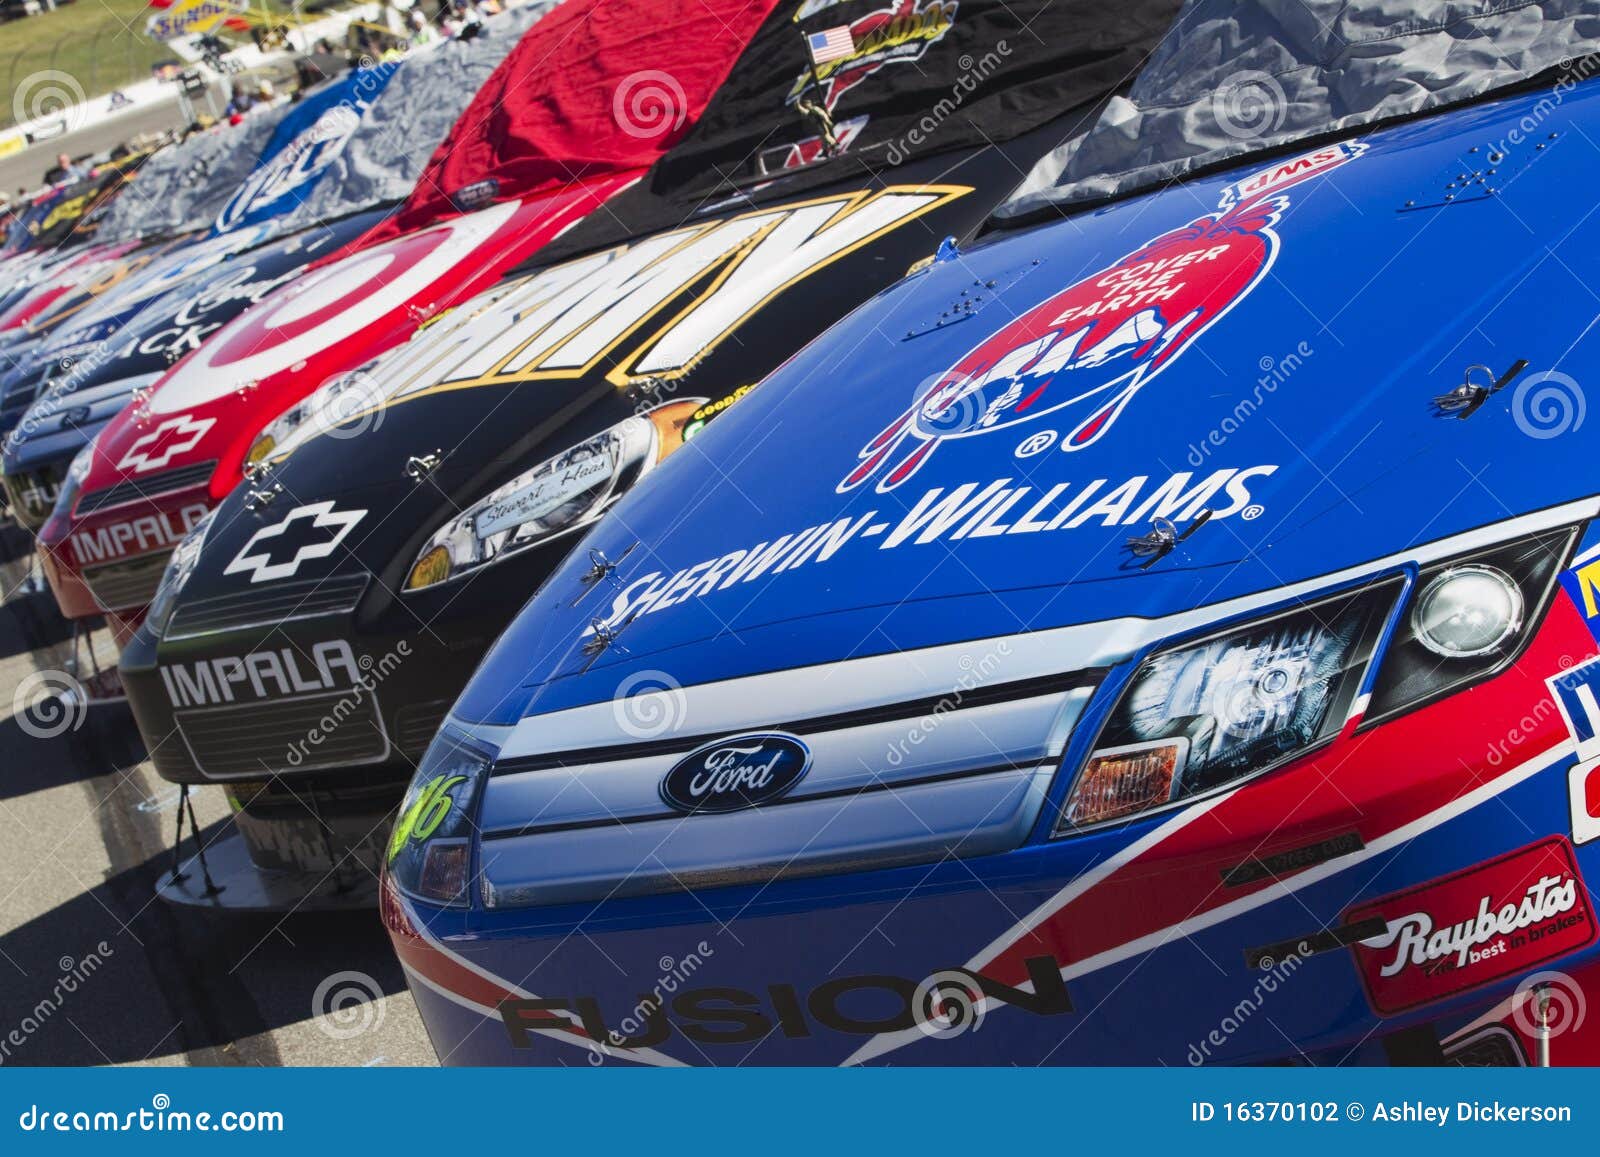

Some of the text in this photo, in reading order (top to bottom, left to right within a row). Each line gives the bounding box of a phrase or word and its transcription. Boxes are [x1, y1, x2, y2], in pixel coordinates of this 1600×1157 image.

[1245, 149, 1335, 192] SWP
[1097, 244, 1231, 287] COVER
[1103, 268, 1183, 298] THE
[1048, 282, 1186, 327] EARTH
[581, 464, 1280, 637] SHERWIN-WILLIAMS
[160, 639, 363, 707] IMPALA
[689, 744, 785, 797] Ford
[1355, 875, 1577, 977] Raybestos
[1469, 938, 1507, 965] best
[1510, 934, 1526, 950] in
[1528, 911, 1585, 941] brakes
[501, 955, 1077, 1049] FUSION
